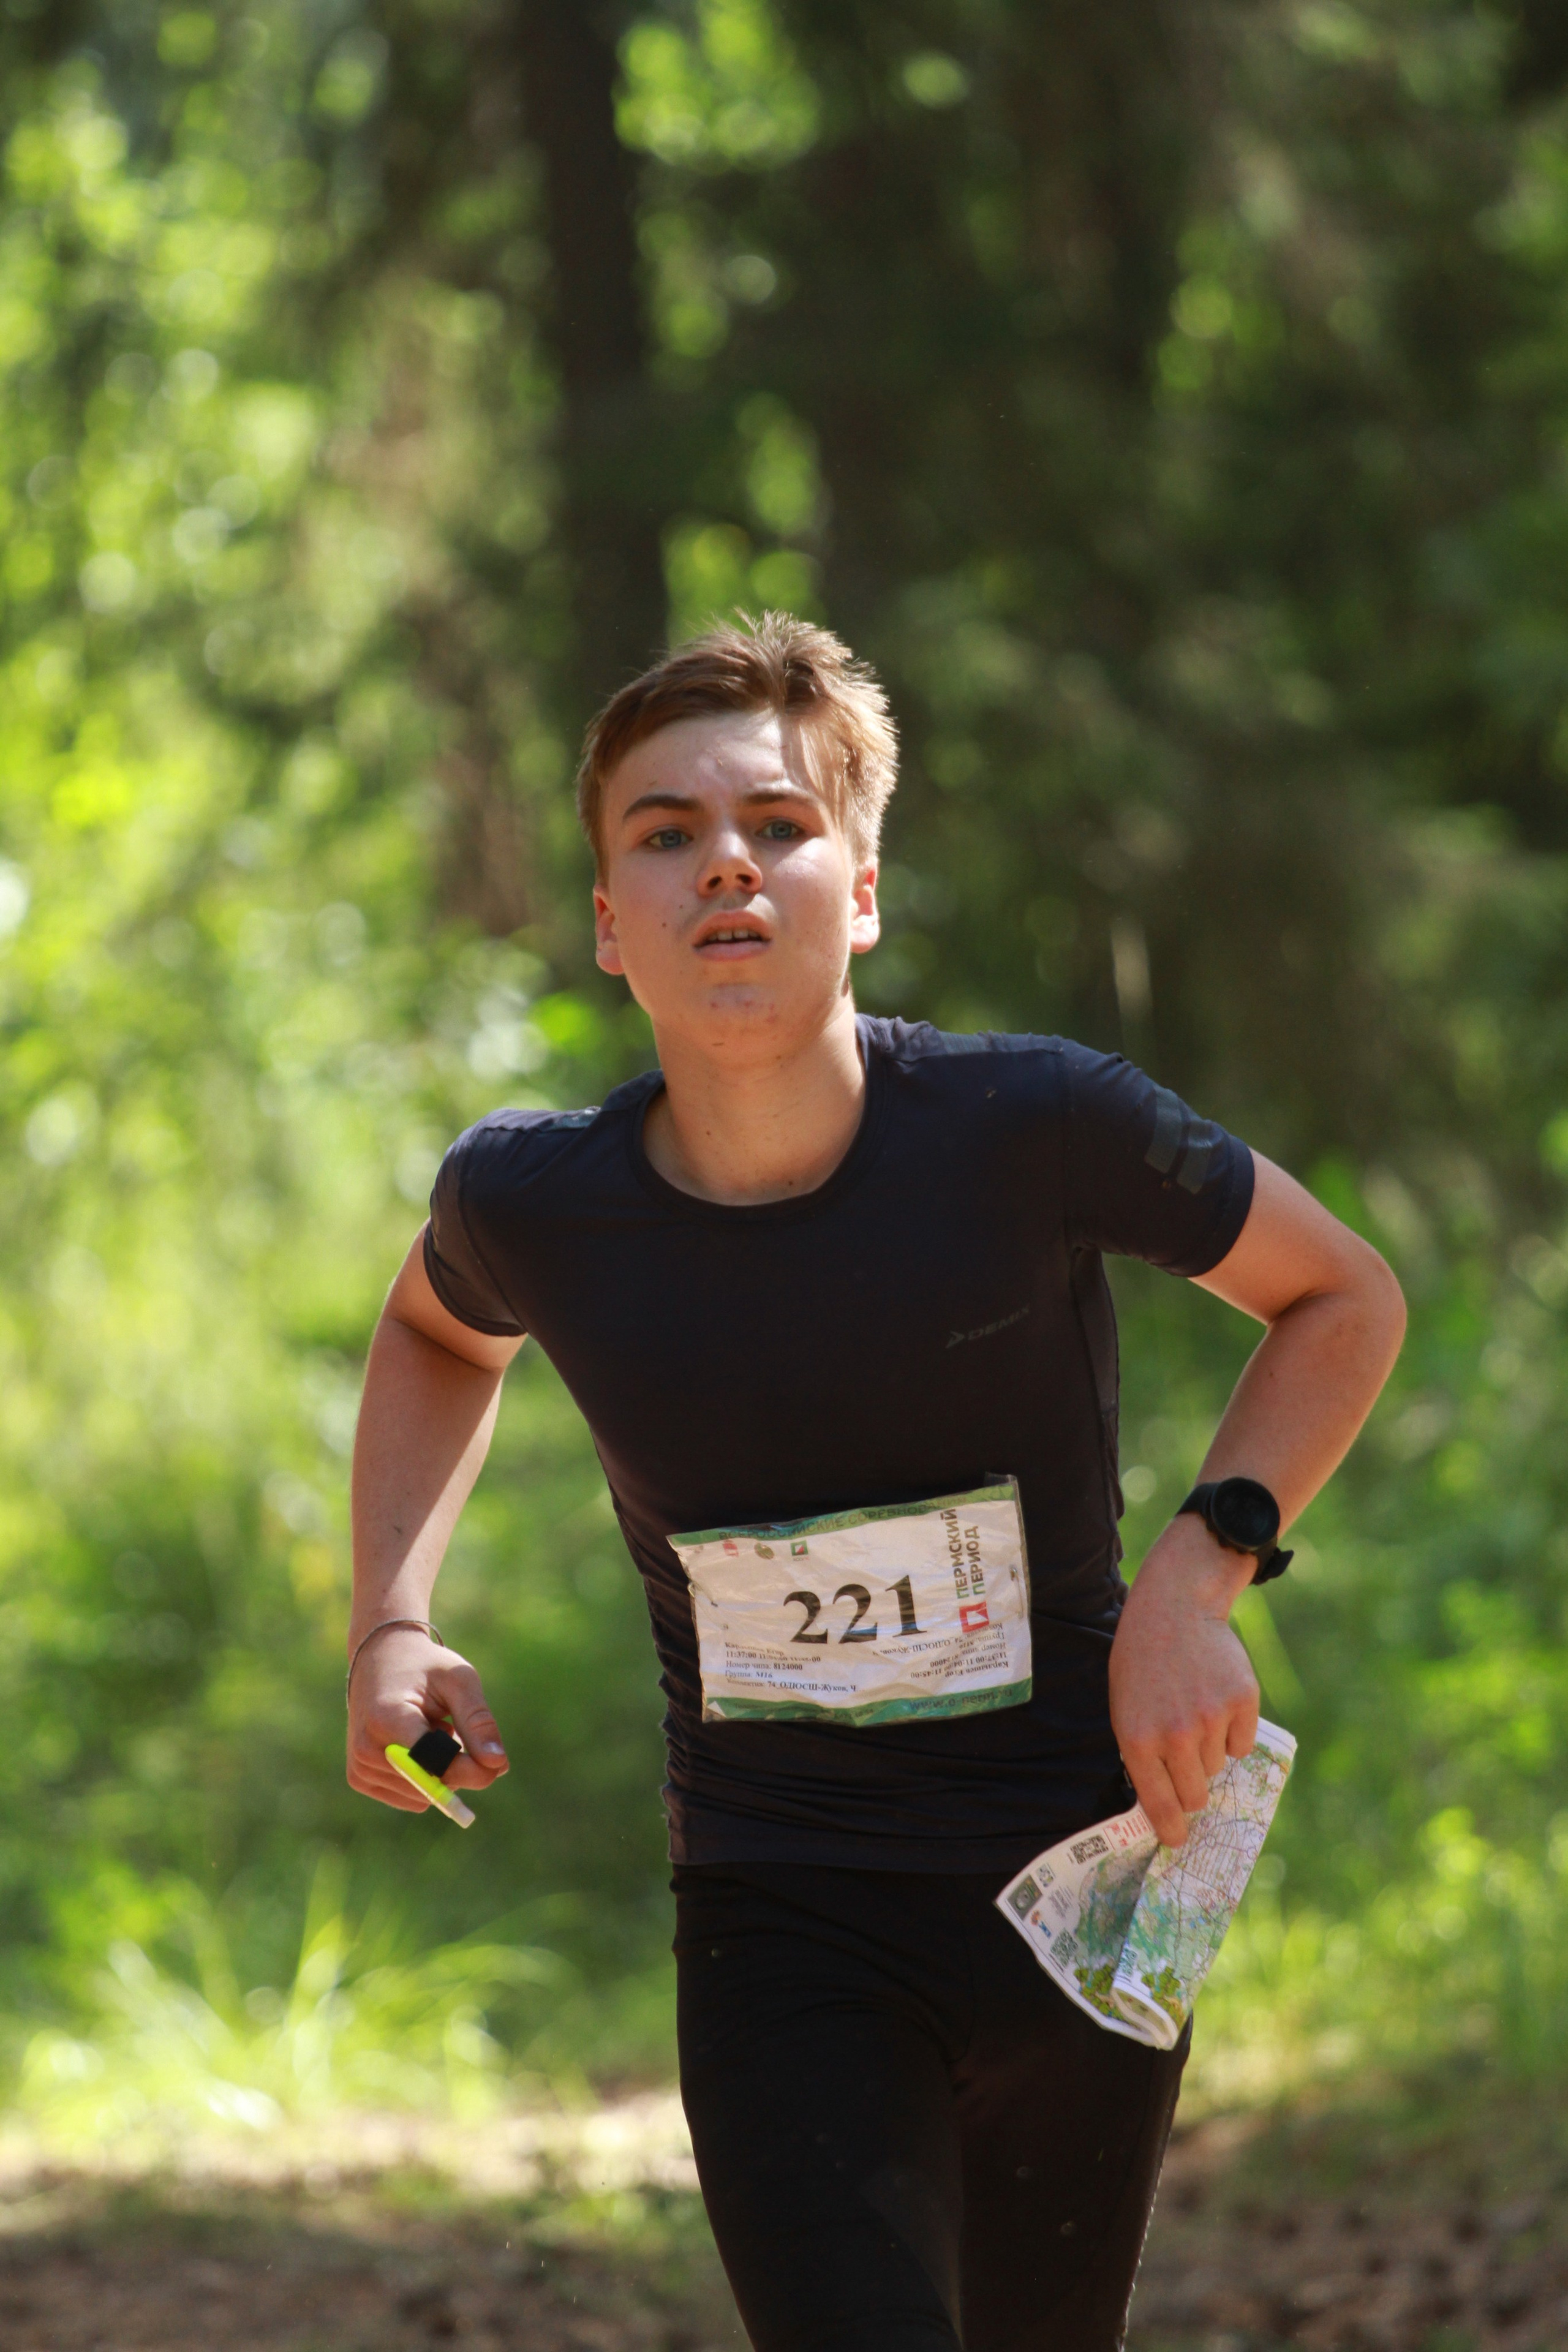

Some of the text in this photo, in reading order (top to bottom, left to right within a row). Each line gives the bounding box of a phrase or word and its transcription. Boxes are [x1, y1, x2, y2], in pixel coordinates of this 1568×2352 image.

[940, 1509, 970, 1599] ПЕРМСКИЙ
[963, 1525, 986, 1595] ПЕРИОД
[783, 1574, 928, 1645] 221
[981, 1642, 1006, 1652] Номер
[726, 1651, 756, 1659] 11:37:00
[976, 1651, 1007, 1664] 11:37:00
[726, 1660, 750, 1669] Номер
[773, 1662, 803, 1671] 8124000
[725, 1670, 753, 1678] Группа:
[910, 1668, 942, 1679] 11:45:00
